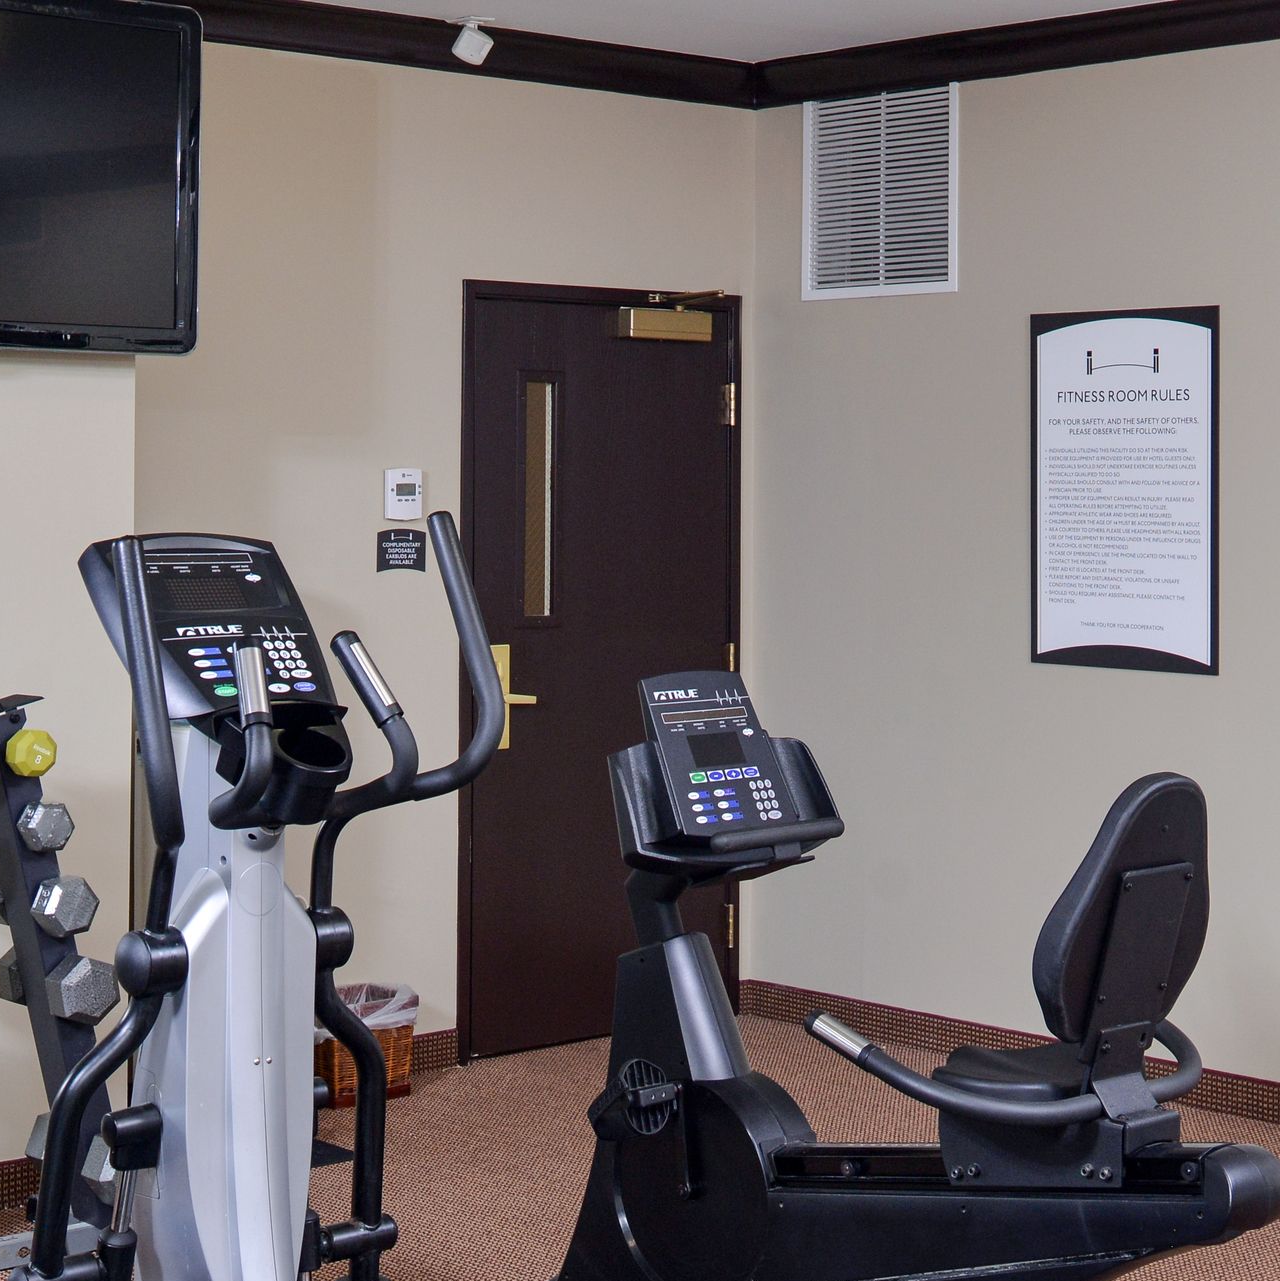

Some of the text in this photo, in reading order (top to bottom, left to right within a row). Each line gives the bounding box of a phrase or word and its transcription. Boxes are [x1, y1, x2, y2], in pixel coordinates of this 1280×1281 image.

[1057, 388, 1190, 403] FITNESS ROOM RULES
[194, 624, 243, 636] TRUE
[666, 688, 698, 700] TRUE
[34, 754, 42, 765] 8
